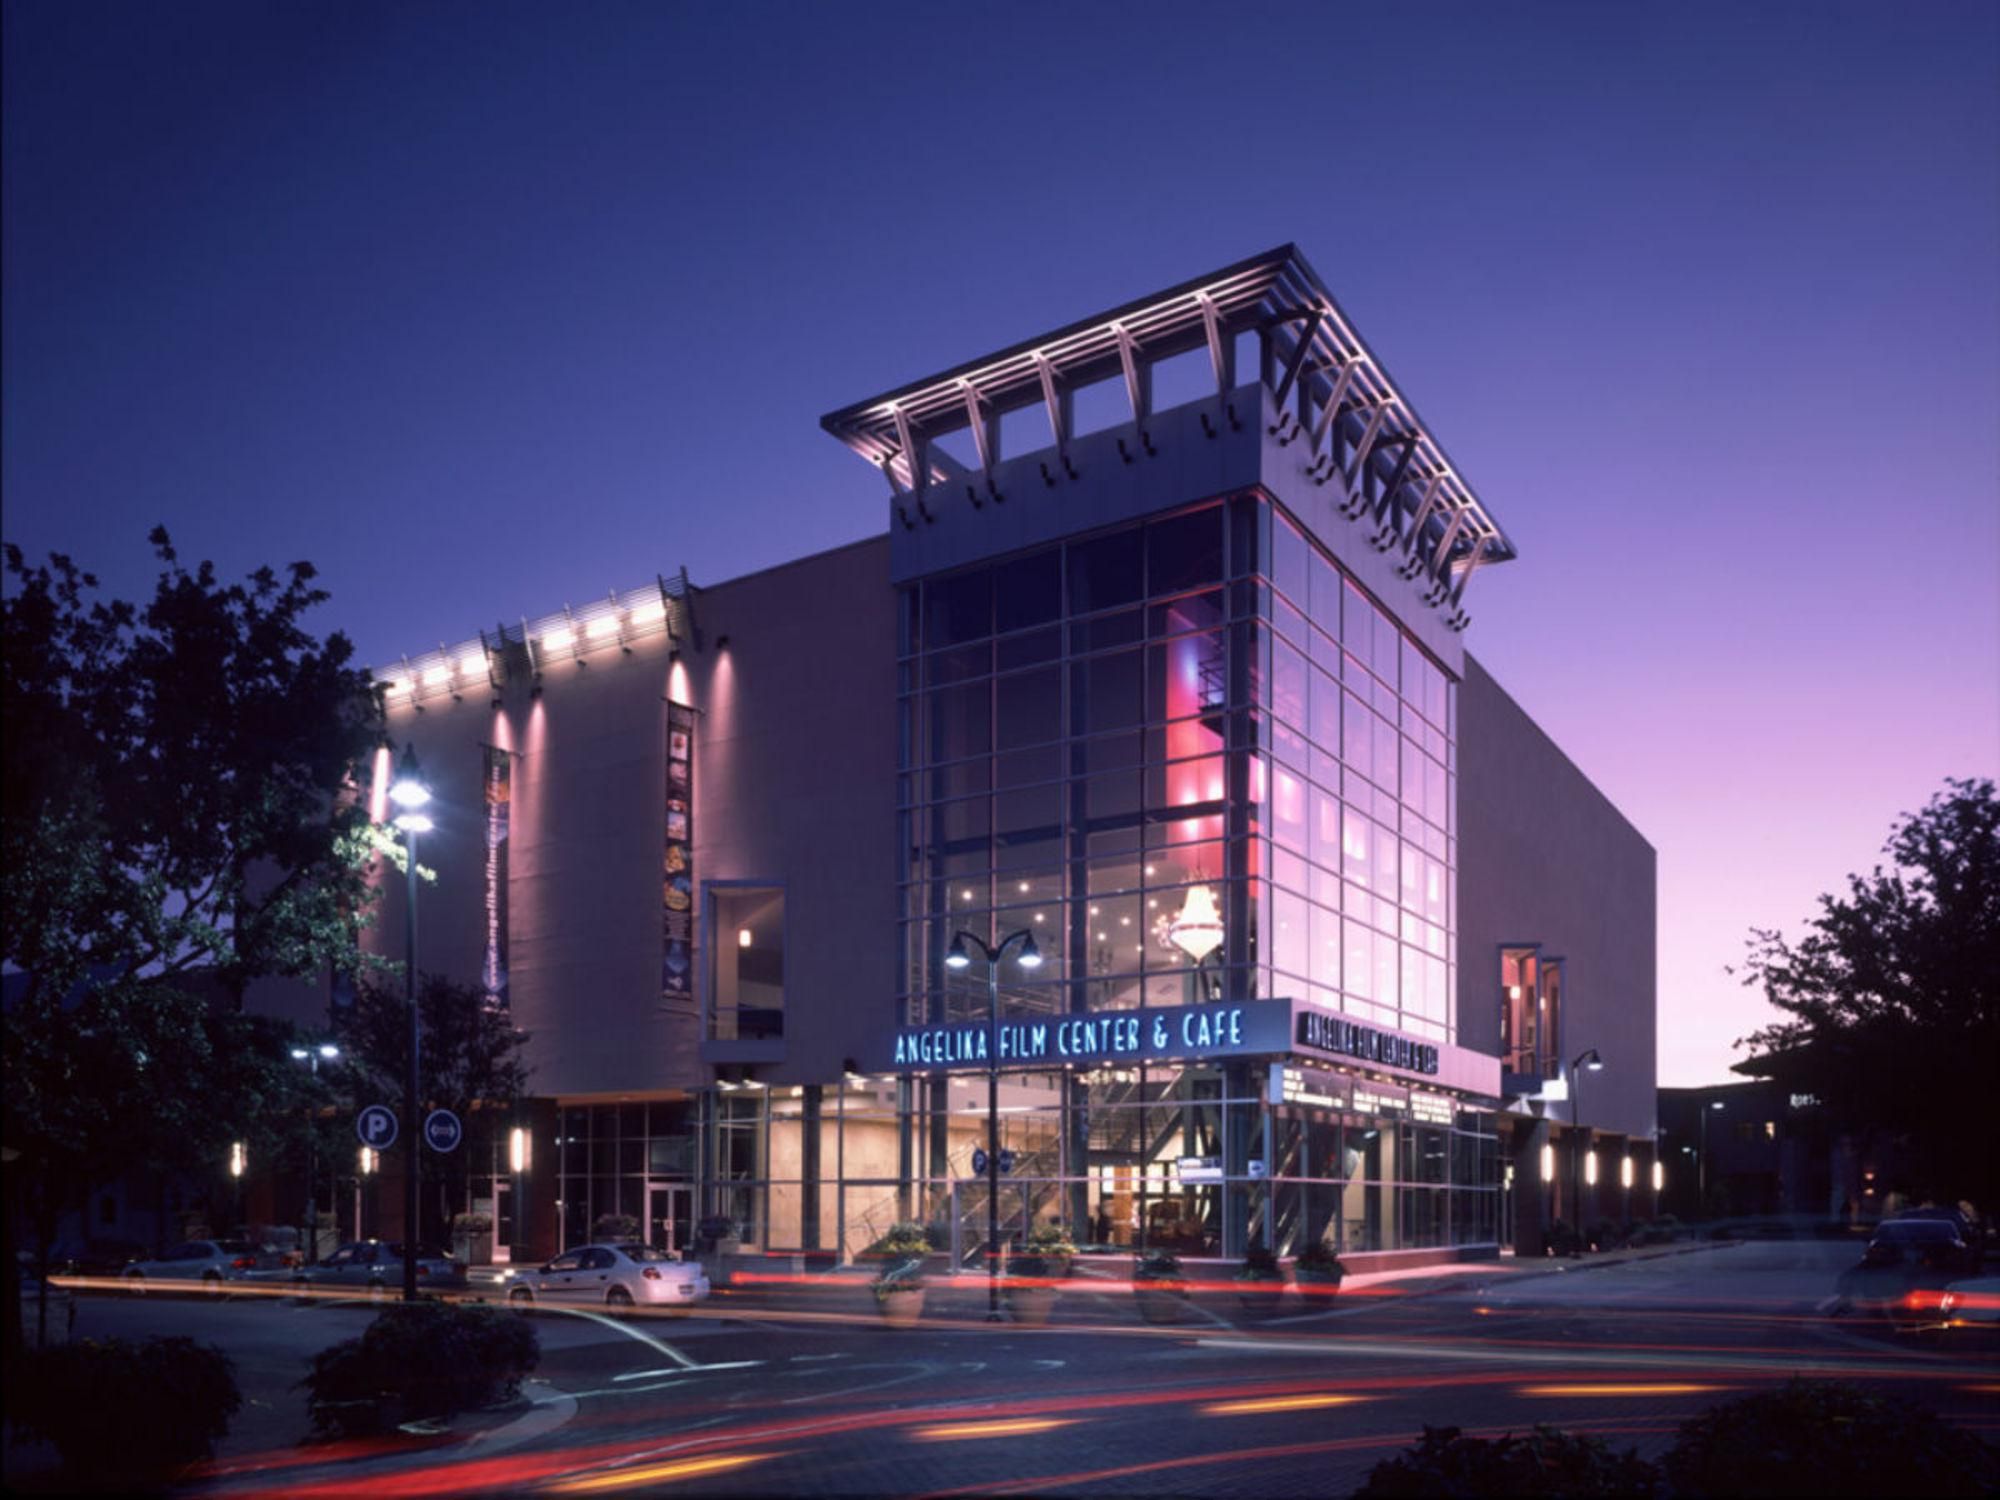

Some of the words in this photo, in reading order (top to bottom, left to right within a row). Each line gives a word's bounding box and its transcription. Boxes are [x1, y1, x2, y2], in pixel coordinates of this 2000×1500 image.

[895, 1029, 987, 1064] ANGELIKA
[1000, 1024, 1046, 1058] FILM
[1058, 1019, 1139, 1055] CENTER
[1153, 1015, 1168, 1049] &
[1182, 1009, 1241, 1048] CAFE
[368, 1114, 387, 1140] P
